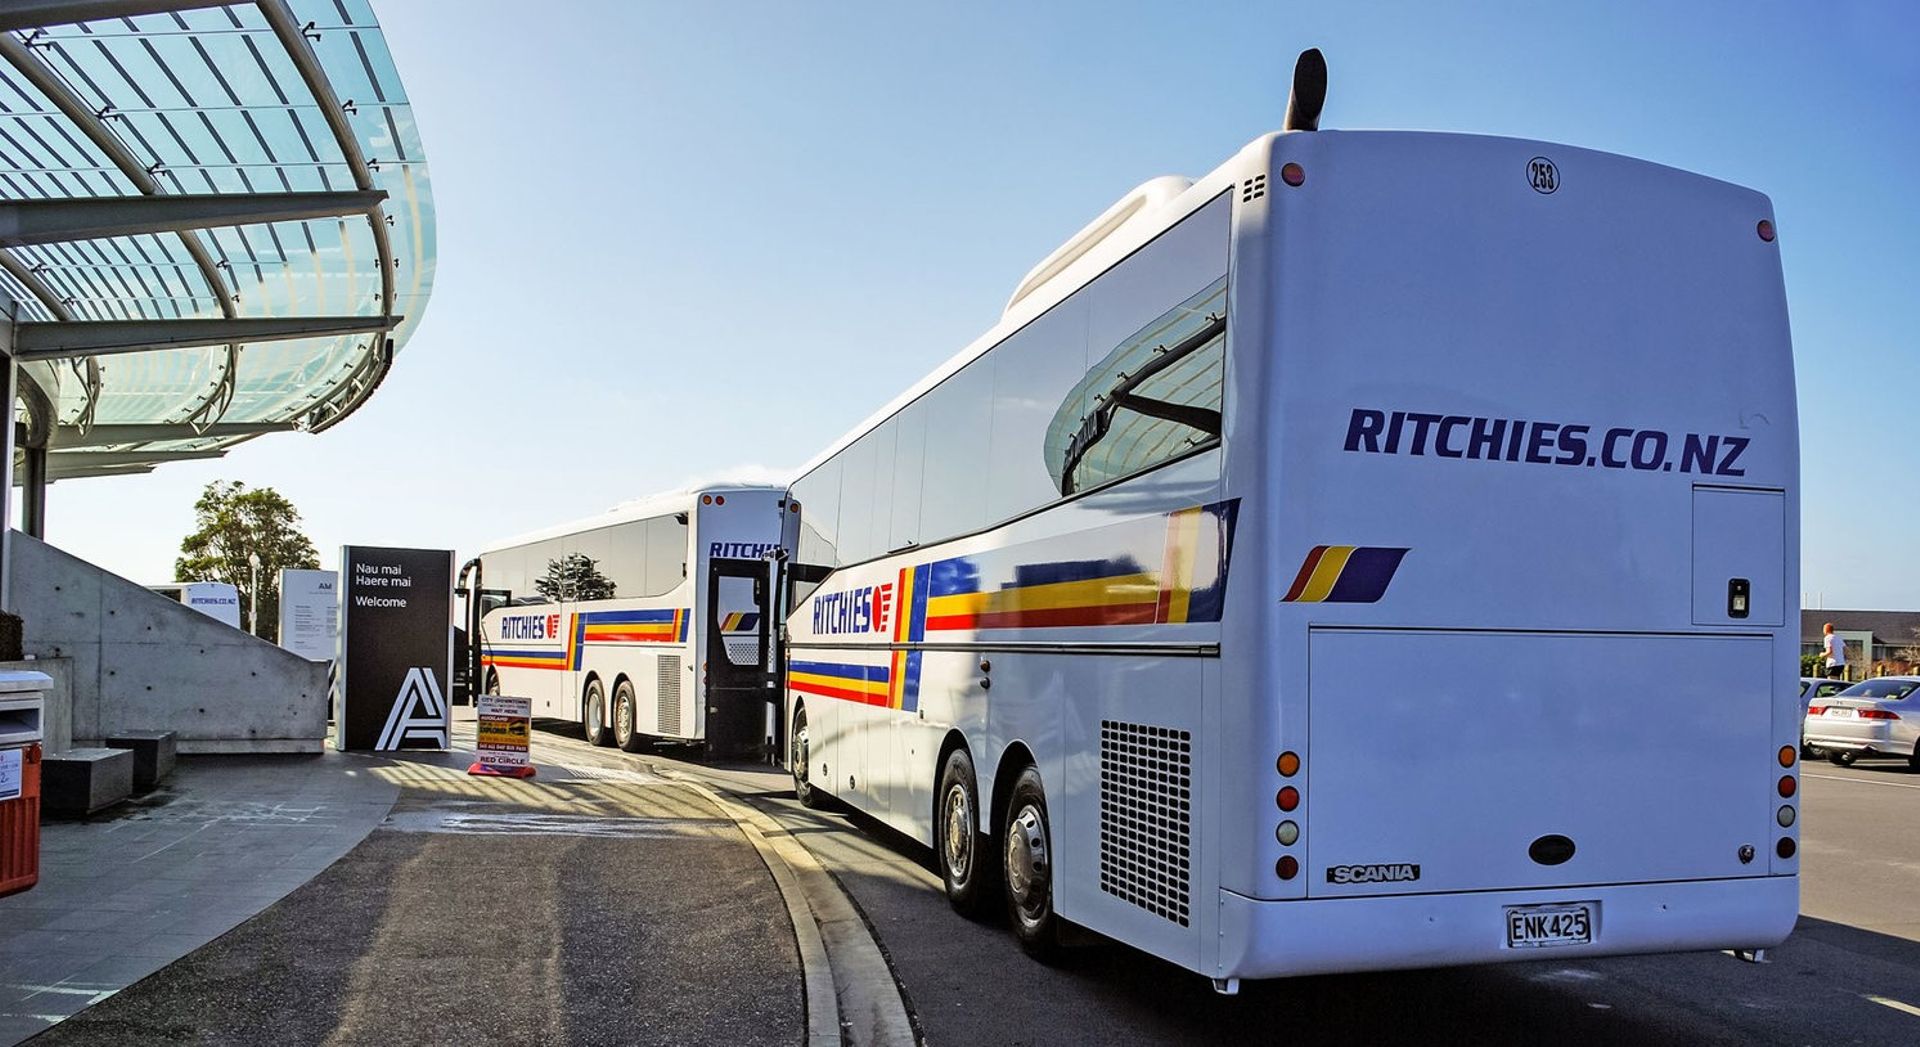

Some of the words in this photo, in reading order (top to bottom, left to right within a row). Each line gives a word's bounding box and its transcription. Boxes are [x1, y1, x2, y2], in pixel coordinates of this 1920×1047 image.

[1532, 162, 1554, 190] 253
[1343, 408, 1751, 477] RITCHIES.CO.NZ
[709, 543, 781, 559] RITCH
[356, 563, 378, 574] Nau
[381, 564, 402, 575] mai
[355, 575, 388, 586] Haere
[391, 576, 411, 587] mai
[355, 596, 407, 608] Welcome
[813, 586, 872, 634] RITCHIES
[501, 615, 545, 640] RITCHIES
[498, 757, 524, 765] CIRCLE
[1334, 865, 1415, 883] SCANIA
[1511, 913, 1588, 940] ENK425
